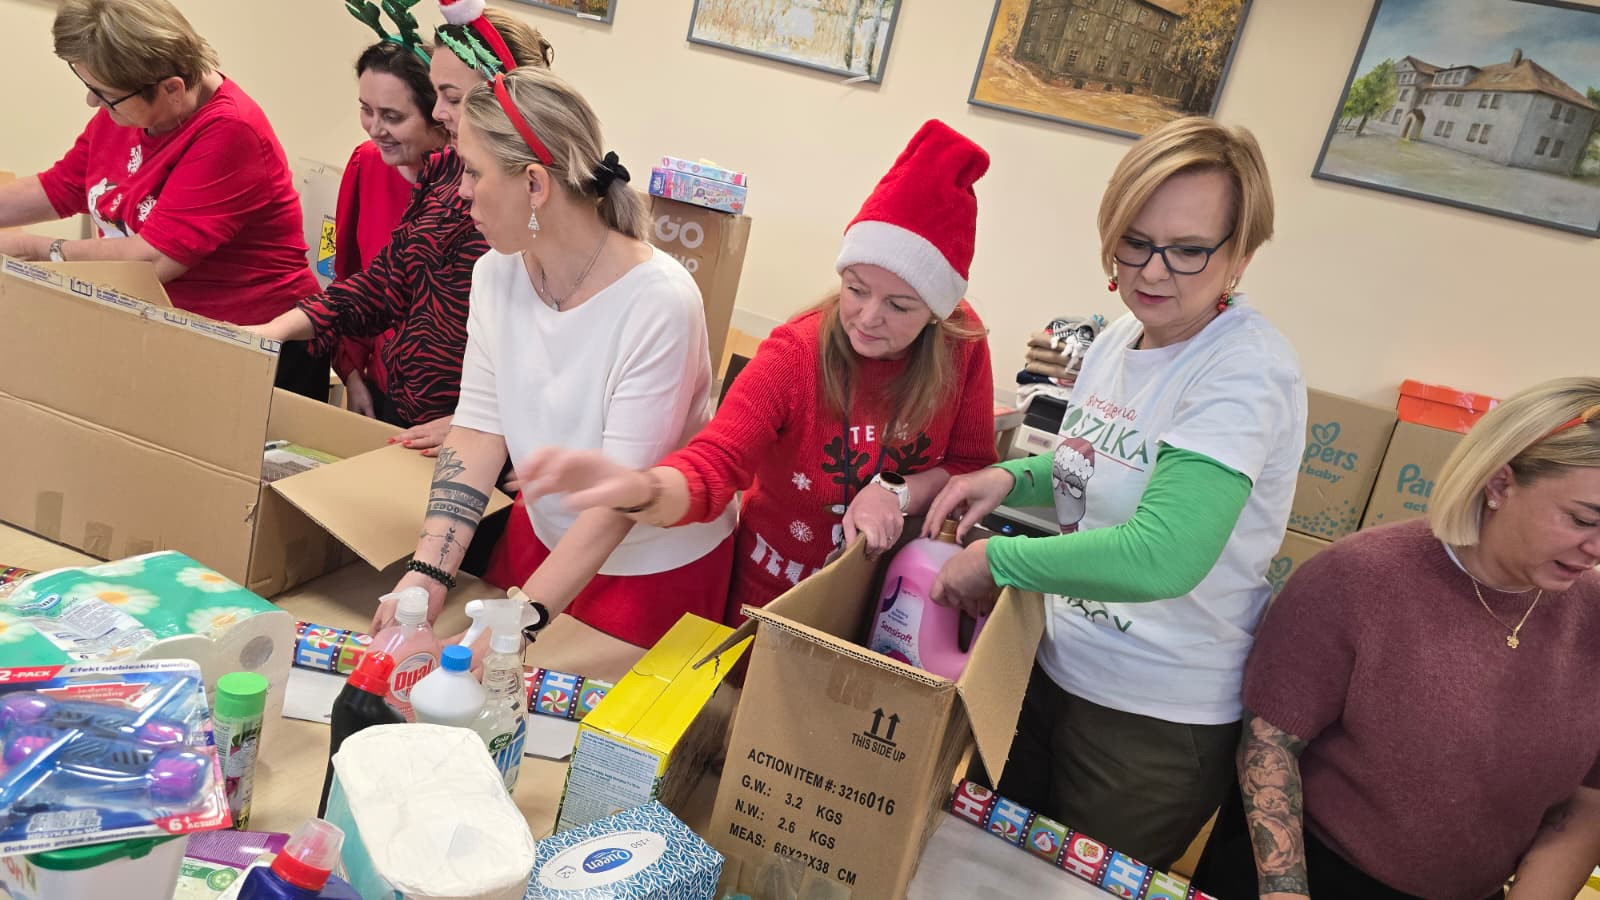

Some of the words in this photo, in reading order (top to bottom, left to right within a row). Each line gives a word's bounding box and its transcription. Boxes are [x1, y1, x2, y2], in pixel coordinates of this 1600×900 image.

[1304, 443, 1358, 471] pers
[851, 733, 870, 750] THIS
[872, 740, 892, 759] SIDE
[892, 748, 906, 763] UP
[741, 774, 772, 797] G.W.:
[785, 793, 803, 810] 3.2
[816, 805, 843, 826] KGS
[747, 748, 793, 776] ACTION
[794, 767, 823, 789] ITEM
[838, 784, 896, 816] 3216016
[735, 799, 765, 821] N.W.:
[777, 817, 796, 833] 2.6
[809, 829, 836, 850] KGS
[585, 849, 631, 870] Queen
[729, 822, 766, 848] MEAS:
[837, 868, 857, 886] CM
